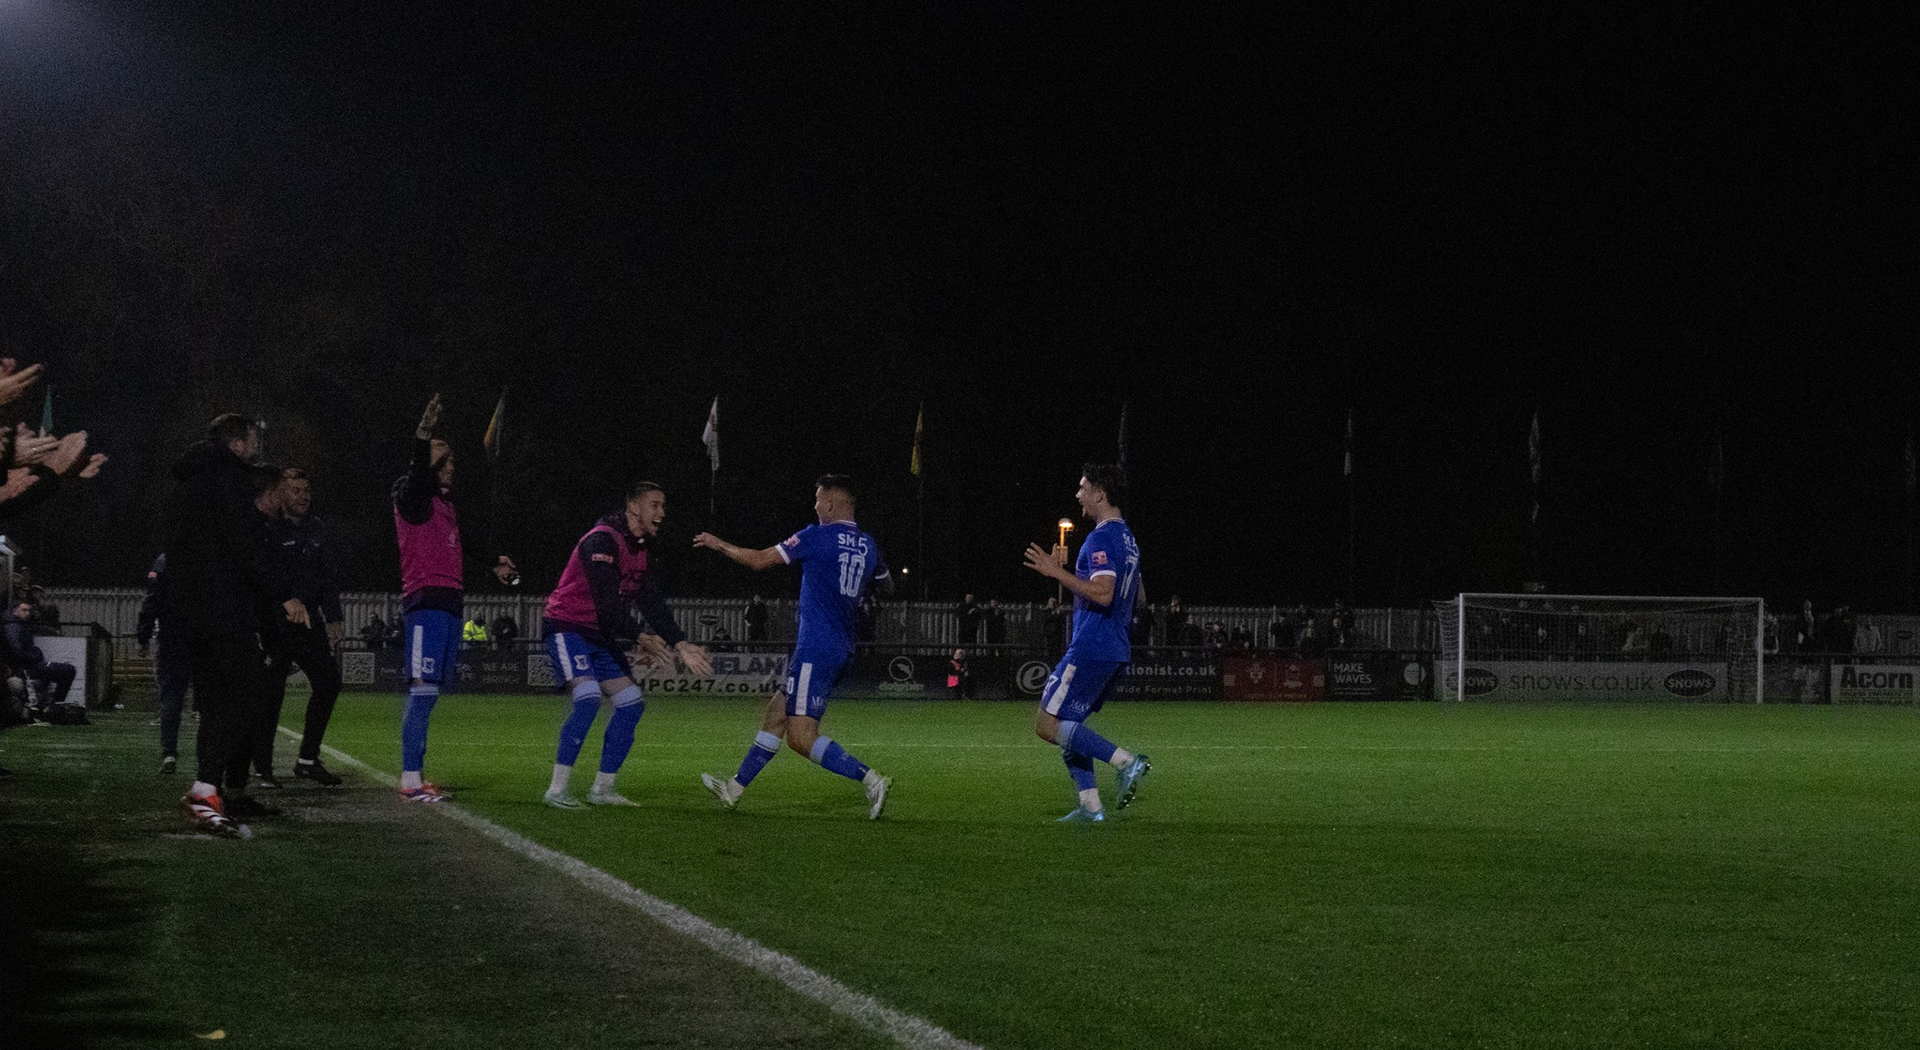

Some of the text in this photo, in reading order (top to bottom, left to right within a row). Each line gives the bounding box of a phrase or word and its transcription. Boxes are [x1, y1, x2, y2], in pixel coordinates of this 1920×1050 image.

[838, 551, 866, 598] 10
[1334, 662, 1364, 673] MAKE
[1334, 674, 1372, 685] WAVES
[1509, 672, 1651, 692] snows.co.uk
[1667, 677, 1713, 689] SNOWS
[1840, 666, 1913, 689] Acorn
[1116, 685, 1212, 694] Wide Format Print
